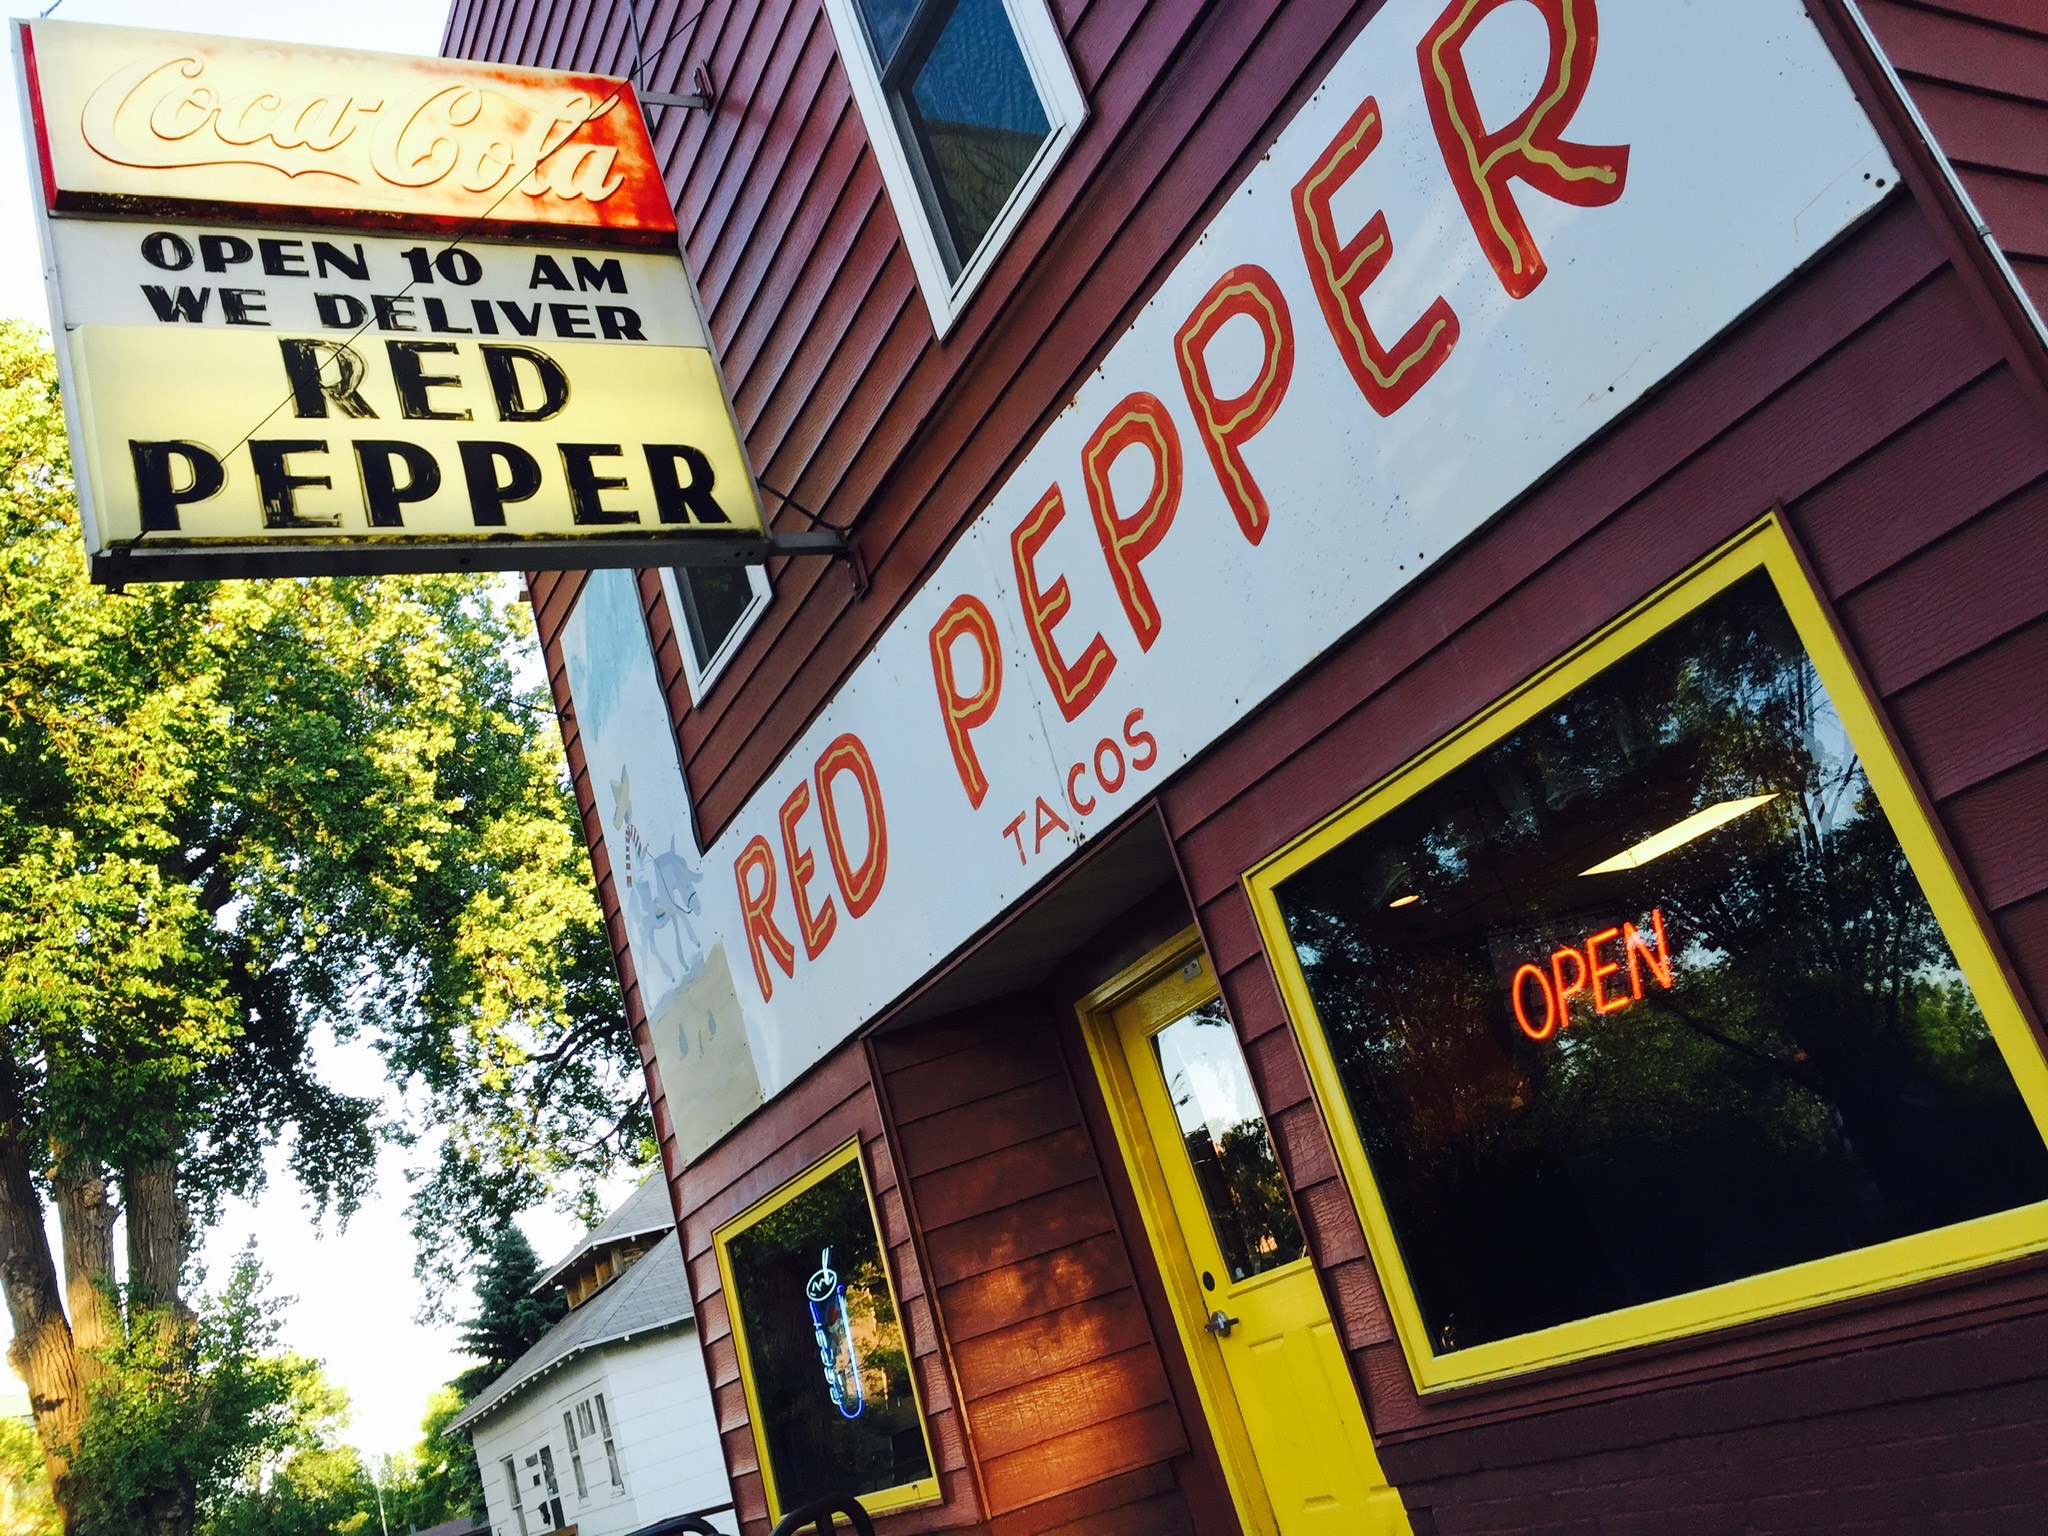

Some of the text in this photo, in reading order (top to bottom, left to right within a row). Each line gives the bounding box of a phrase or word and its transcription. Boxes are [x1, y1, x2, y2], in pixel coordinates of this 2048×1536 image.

[82, 52, 626, 203] Coca-Cola
[140, 284, 648, 341] WE DELIVER
[141, 231, 628, 294] OPEN 10 AM
[277, 336, 571, 423] RED
[128, 438, 731, 531] PEPPER
[734, 0, 1631, 1003] RED PEPPER
[1002, 708, 1158, 866] TACOS
[1511, 907, 1673, 1040] OPEN
